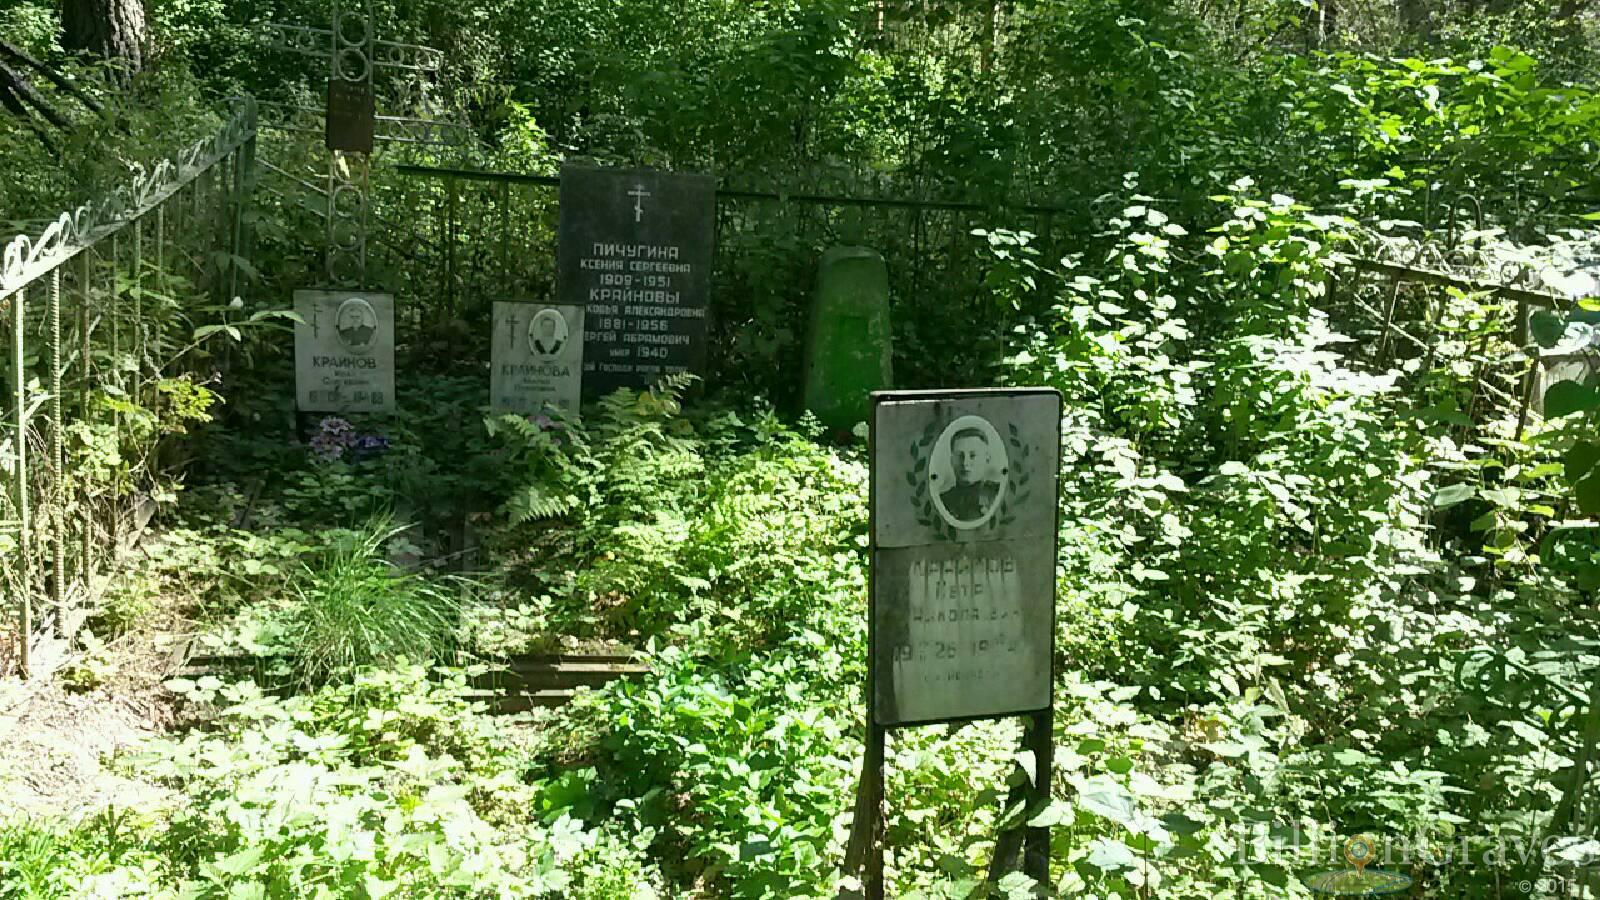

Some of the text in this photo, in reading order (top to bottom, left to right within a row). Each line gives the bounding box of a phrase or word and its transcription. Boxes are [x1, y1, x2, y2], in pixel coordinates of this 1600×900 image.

[593, 243, 679, 260] ПИЧУГИНА
[580, 259, 691, 273] КСЕНИЯ СЕРГЕЕВНА
